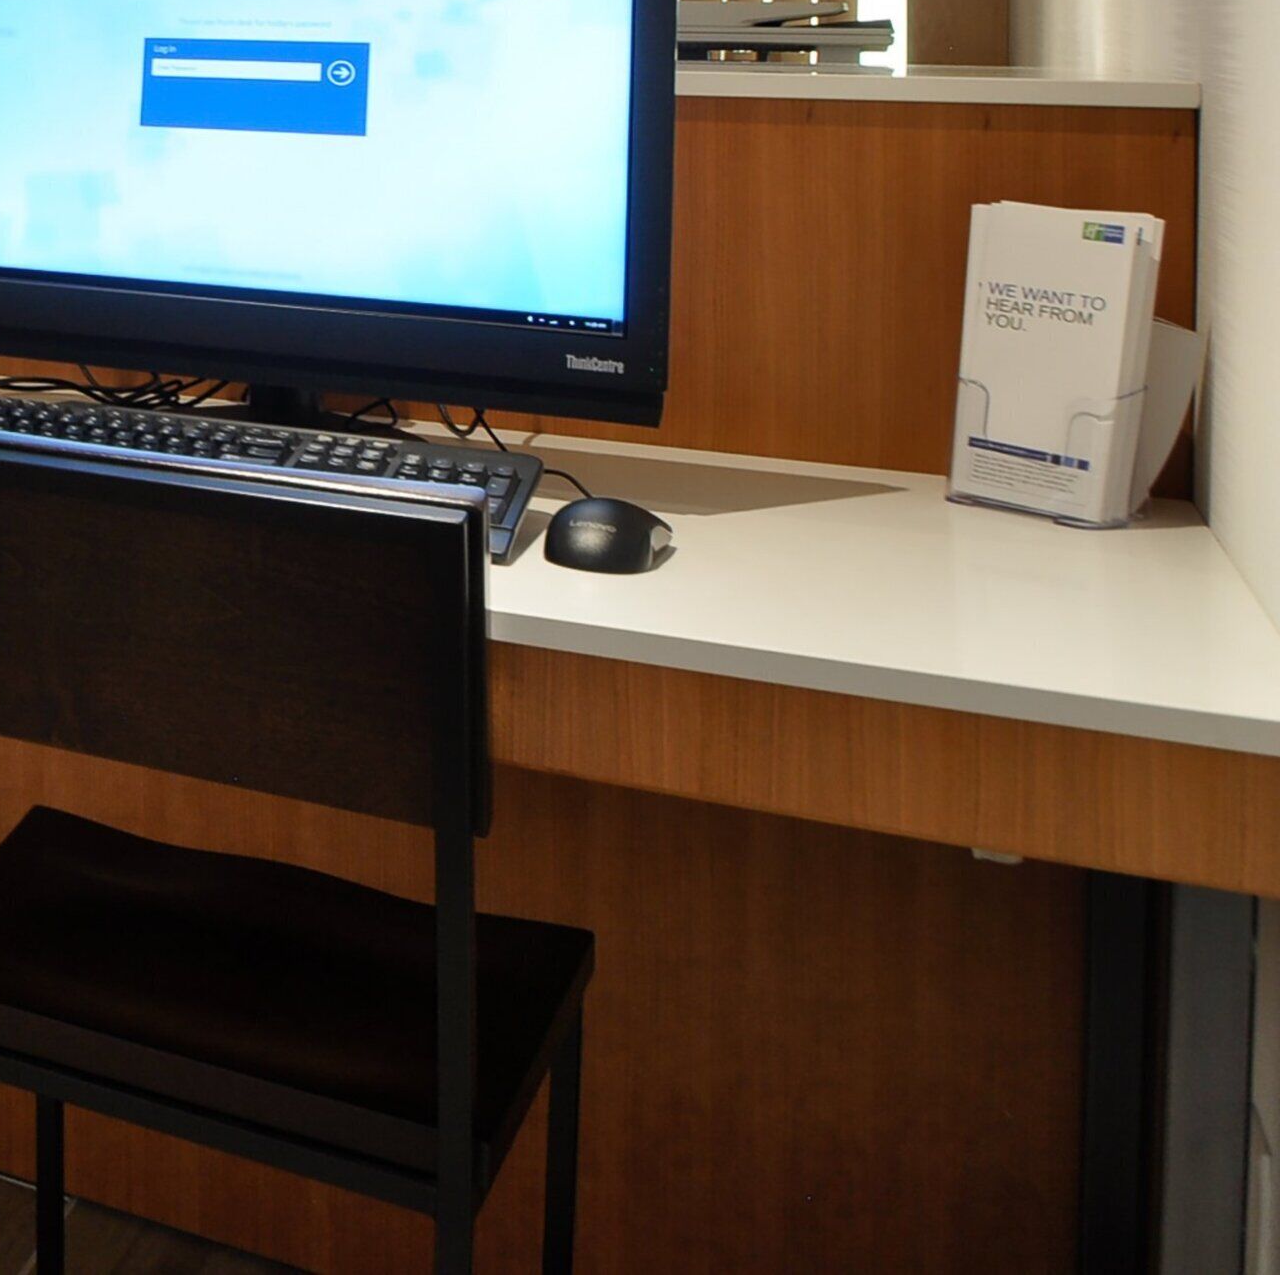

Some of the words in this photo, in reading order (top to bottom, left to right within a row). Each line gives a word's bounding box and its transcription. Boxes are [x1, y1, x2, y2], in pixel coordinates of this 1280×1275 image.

[988, 281, 1018, 298] WE
[1021, 286, 1075, 306] WANT
[1080, 294, 1106, 311] TO
[985, 312, 1028, 331] YOU.
[986, 297, 1033, 317] HEAR
[1038, 305, 1094, 325] FROM
[566, 354, 624, 374] ThinkCentre
